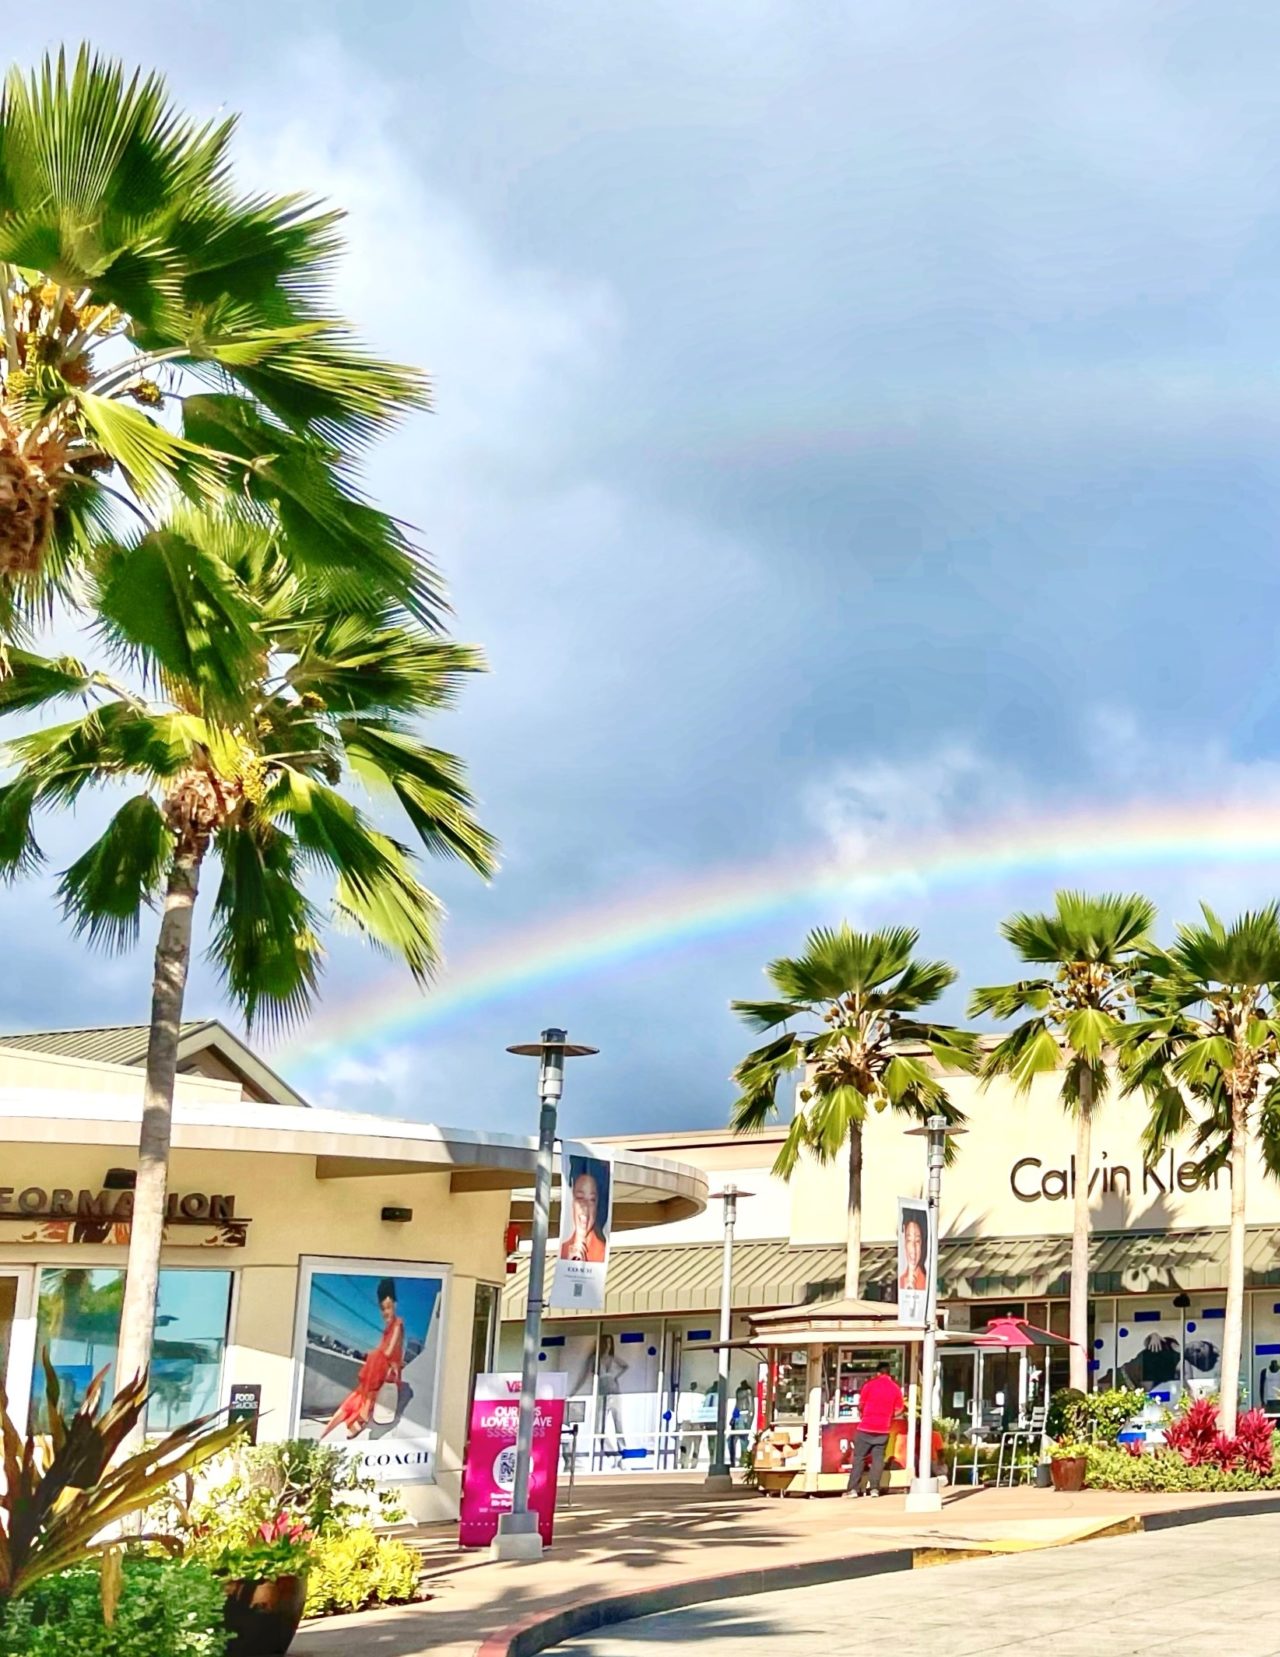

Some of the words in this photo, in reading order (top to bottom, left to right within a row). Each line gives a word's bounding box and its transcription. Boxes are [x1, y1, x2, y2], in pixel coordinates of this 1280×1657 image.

[235, 1393, 255, 1402] FOOD
[494, 1406, 518, 1417] OUR
[481, 1416, 509, 1428] LOVE
[532, 1416, 552, 1427] AVE
[364, 1451, 429, 1467] COACH
